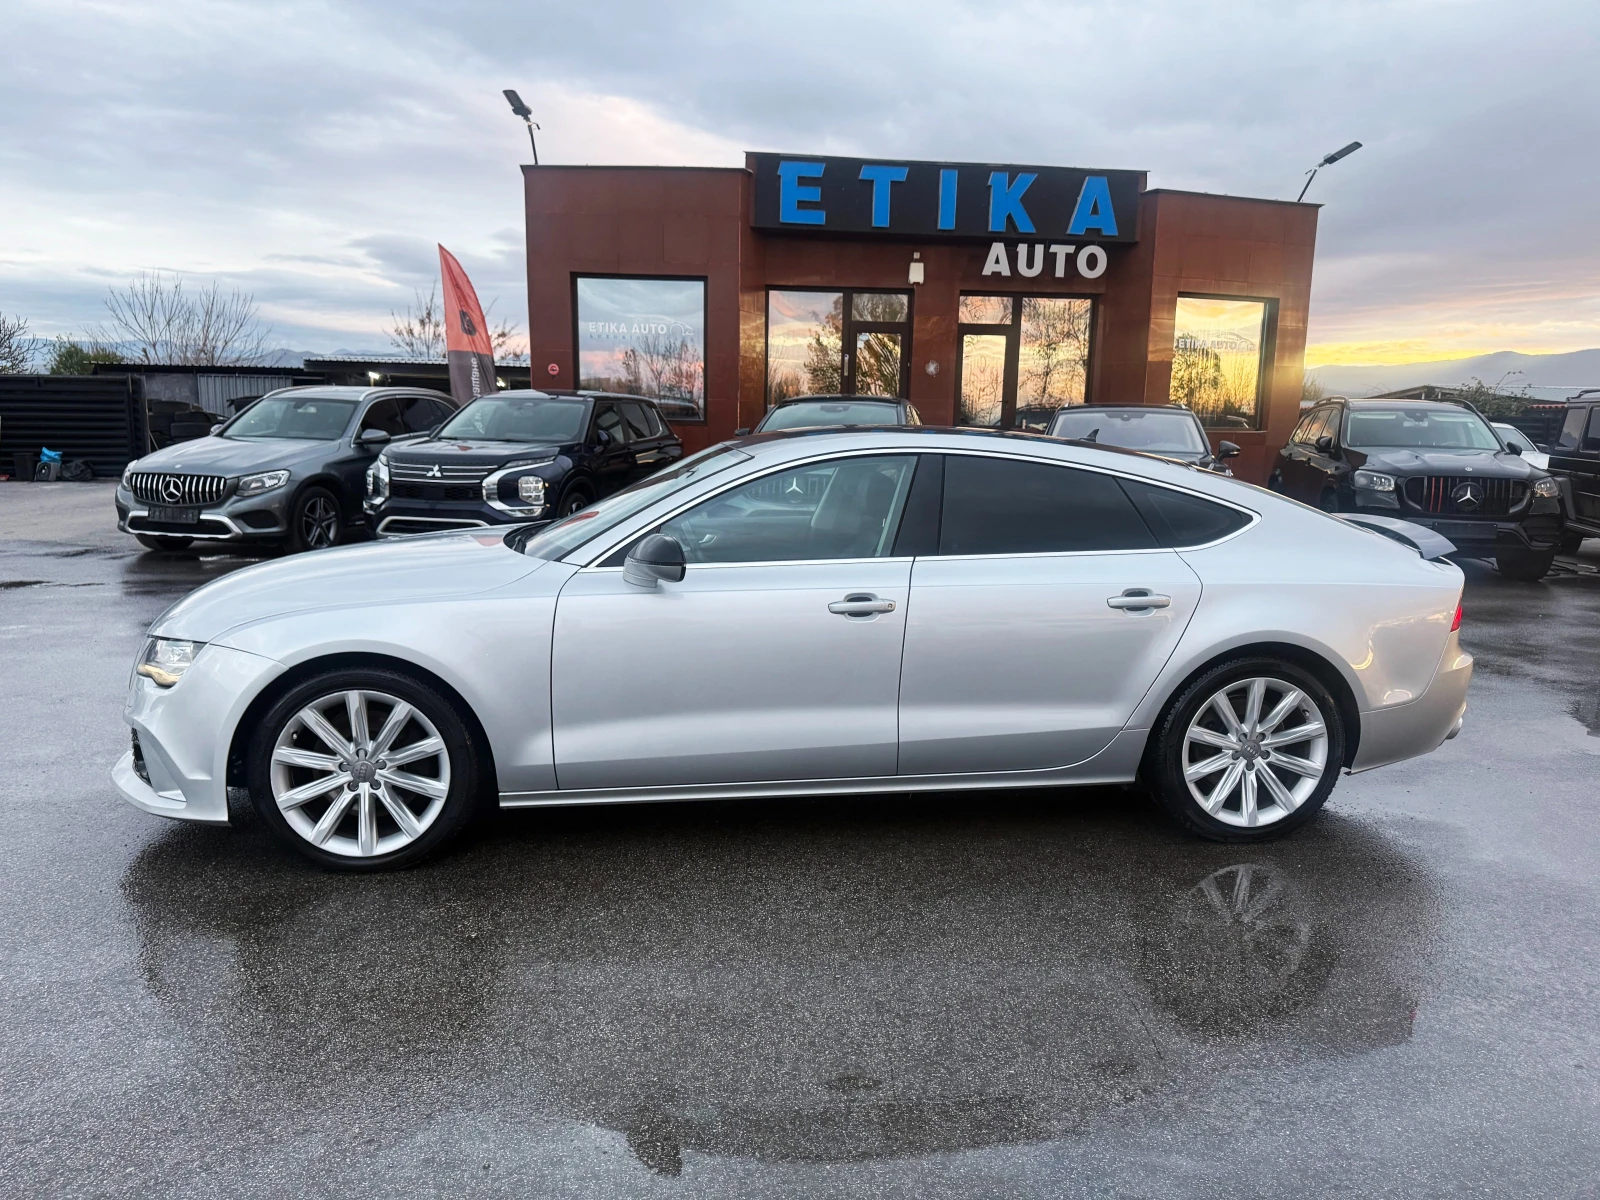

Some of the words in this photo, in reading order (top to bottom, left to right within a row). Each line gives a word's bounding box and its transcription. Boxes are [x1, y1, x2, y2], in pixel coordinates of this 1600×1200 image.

[777, 160, 1118, 236] ETIKA
[981, 242, 1108, 279] AUTO
[589, 321, 628, 334] ETIKA
[631, 323, 667, 335] AUTO
[1178, 338, 1208, 349] ETIKA
[1210, 340, 1237, 350] AUTO
